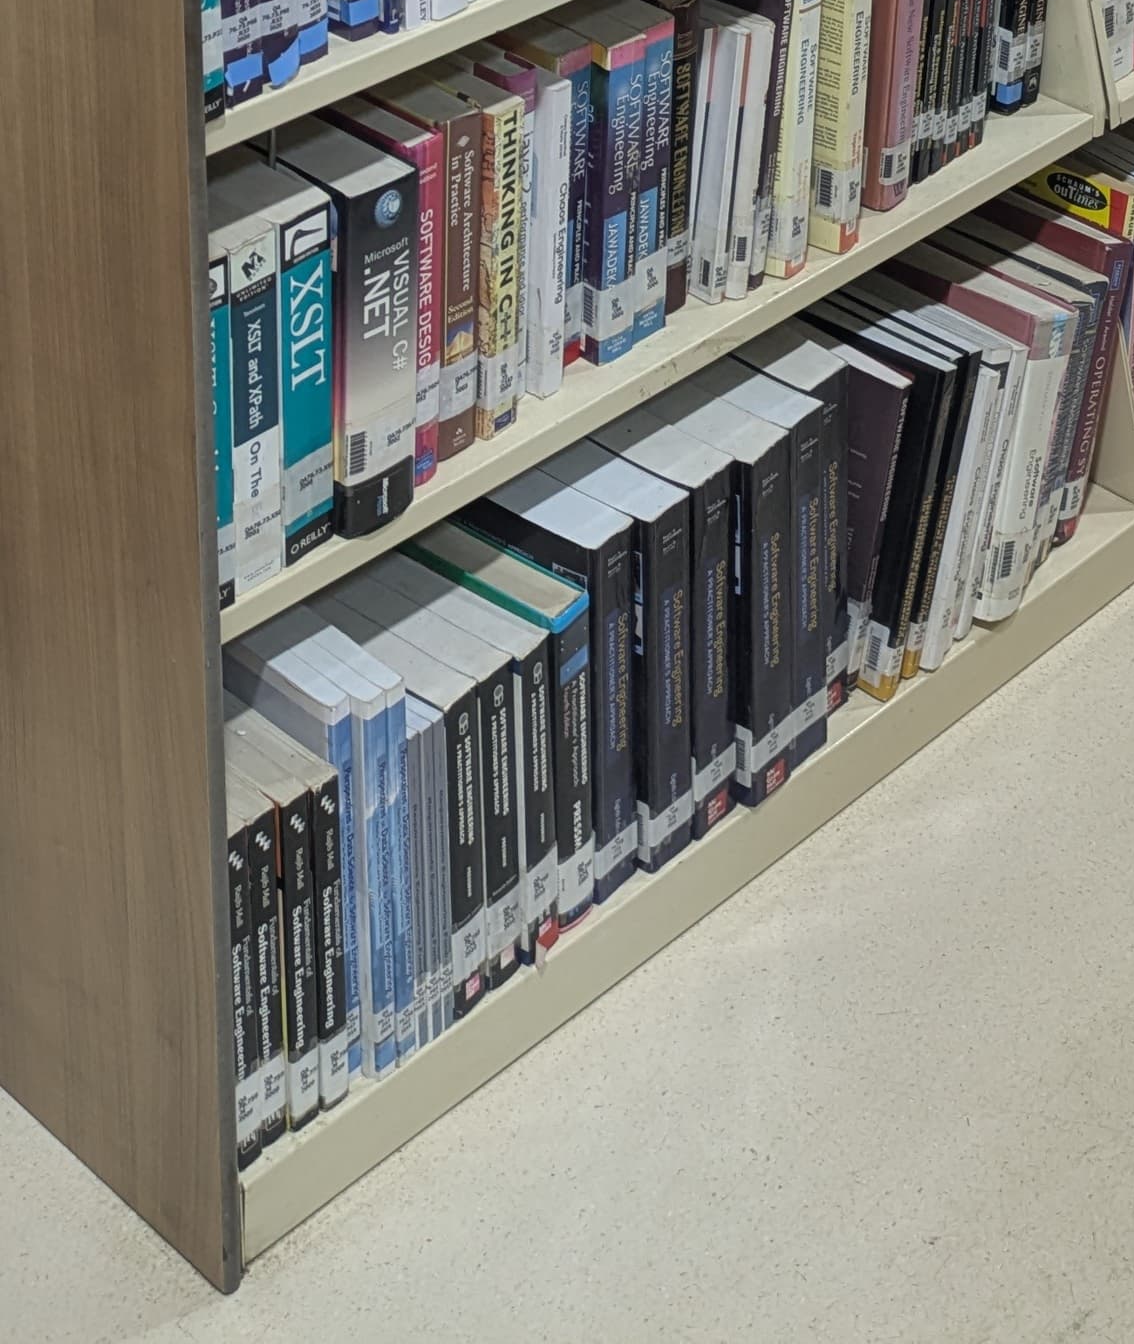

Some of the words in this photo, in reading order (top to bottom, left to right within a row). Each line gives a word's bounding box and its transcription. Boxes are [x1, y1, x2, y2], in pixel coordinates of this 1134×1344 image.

[796, 38, 810, 126] ENGINEERING
[807, 43, 817, 112] SOFTWARE
[608, 96, 628, 196] Engineering
[626, 73, 643, 172] SOFTWARE
[452, 155, 462, 172] in
[463, 150, 475, 209] Software
[500, 110, 518, 249] THINKING
[1055, 174, 1101, 197] SCHAUM'S
[450, 174, 462, 228] Practice
[364, 237, 409, 266] Microsoft
[418, 208, 434, 307] SOFTWARE
[462, 211, 473, 292] Architecture
[500, 254, 514, 290] IN
[363, 266, 390, 341] .NET
[393, 250, 410, 338] VISUAL
[246, 318, 262, 351] XSLT
[289, 260, 327, 392] XSLT
[392, 340, 409, 371] C#
[247, 357, 261, 381] and
[247, 384, 262, 431] XPath
[249, 440, 261, 465] On
[250, 468, 260, 498] The
[322, 886, 333, 946] Software
[323, 948, 335, 1030] Engineering
